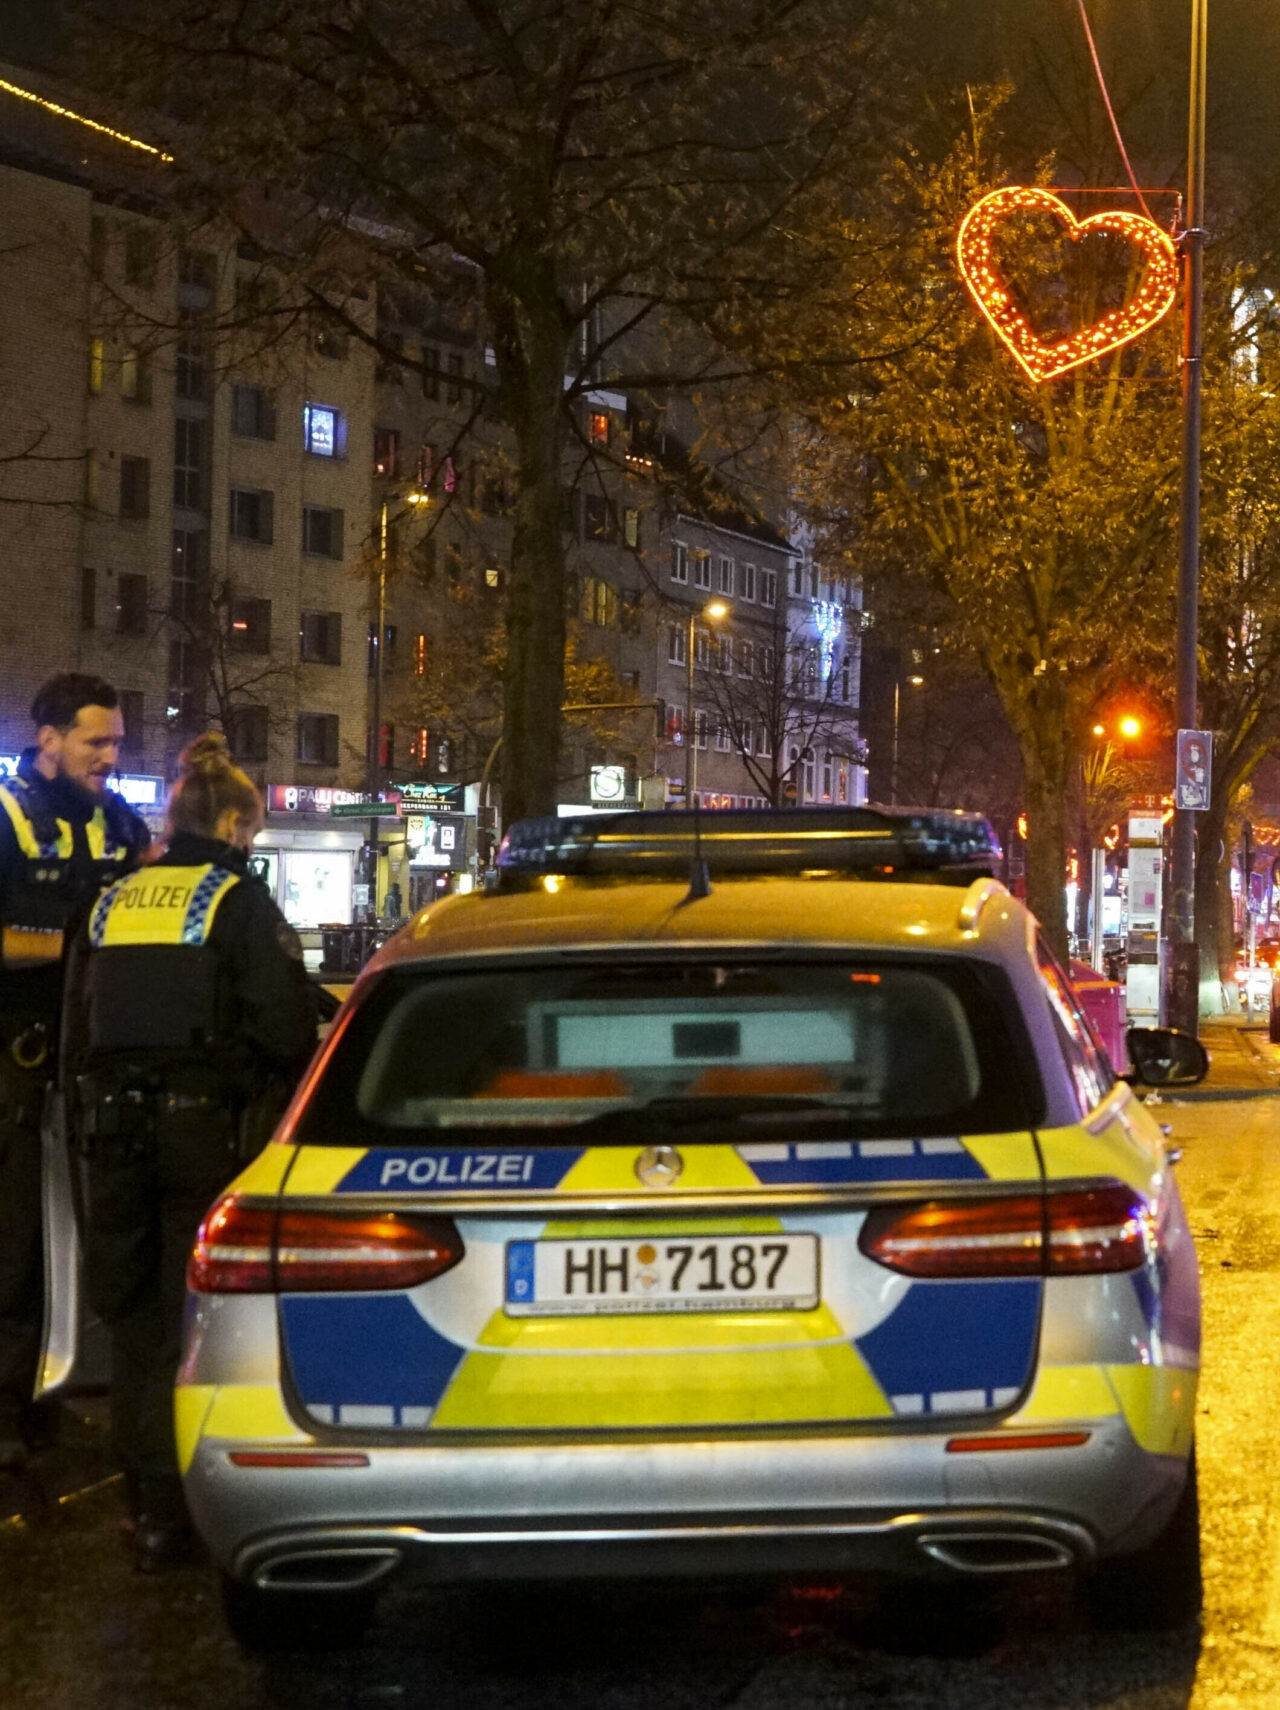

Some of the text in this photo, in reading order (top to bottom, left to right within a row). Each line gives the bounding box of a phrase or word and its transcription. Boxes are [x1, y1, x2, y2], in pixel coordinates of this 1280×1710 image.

[112, 885, 193, 910] POLIZEI
[380, 1155, 535, 1187] POLIZEI
[565, 1243, 789, 1295] HH 7187
